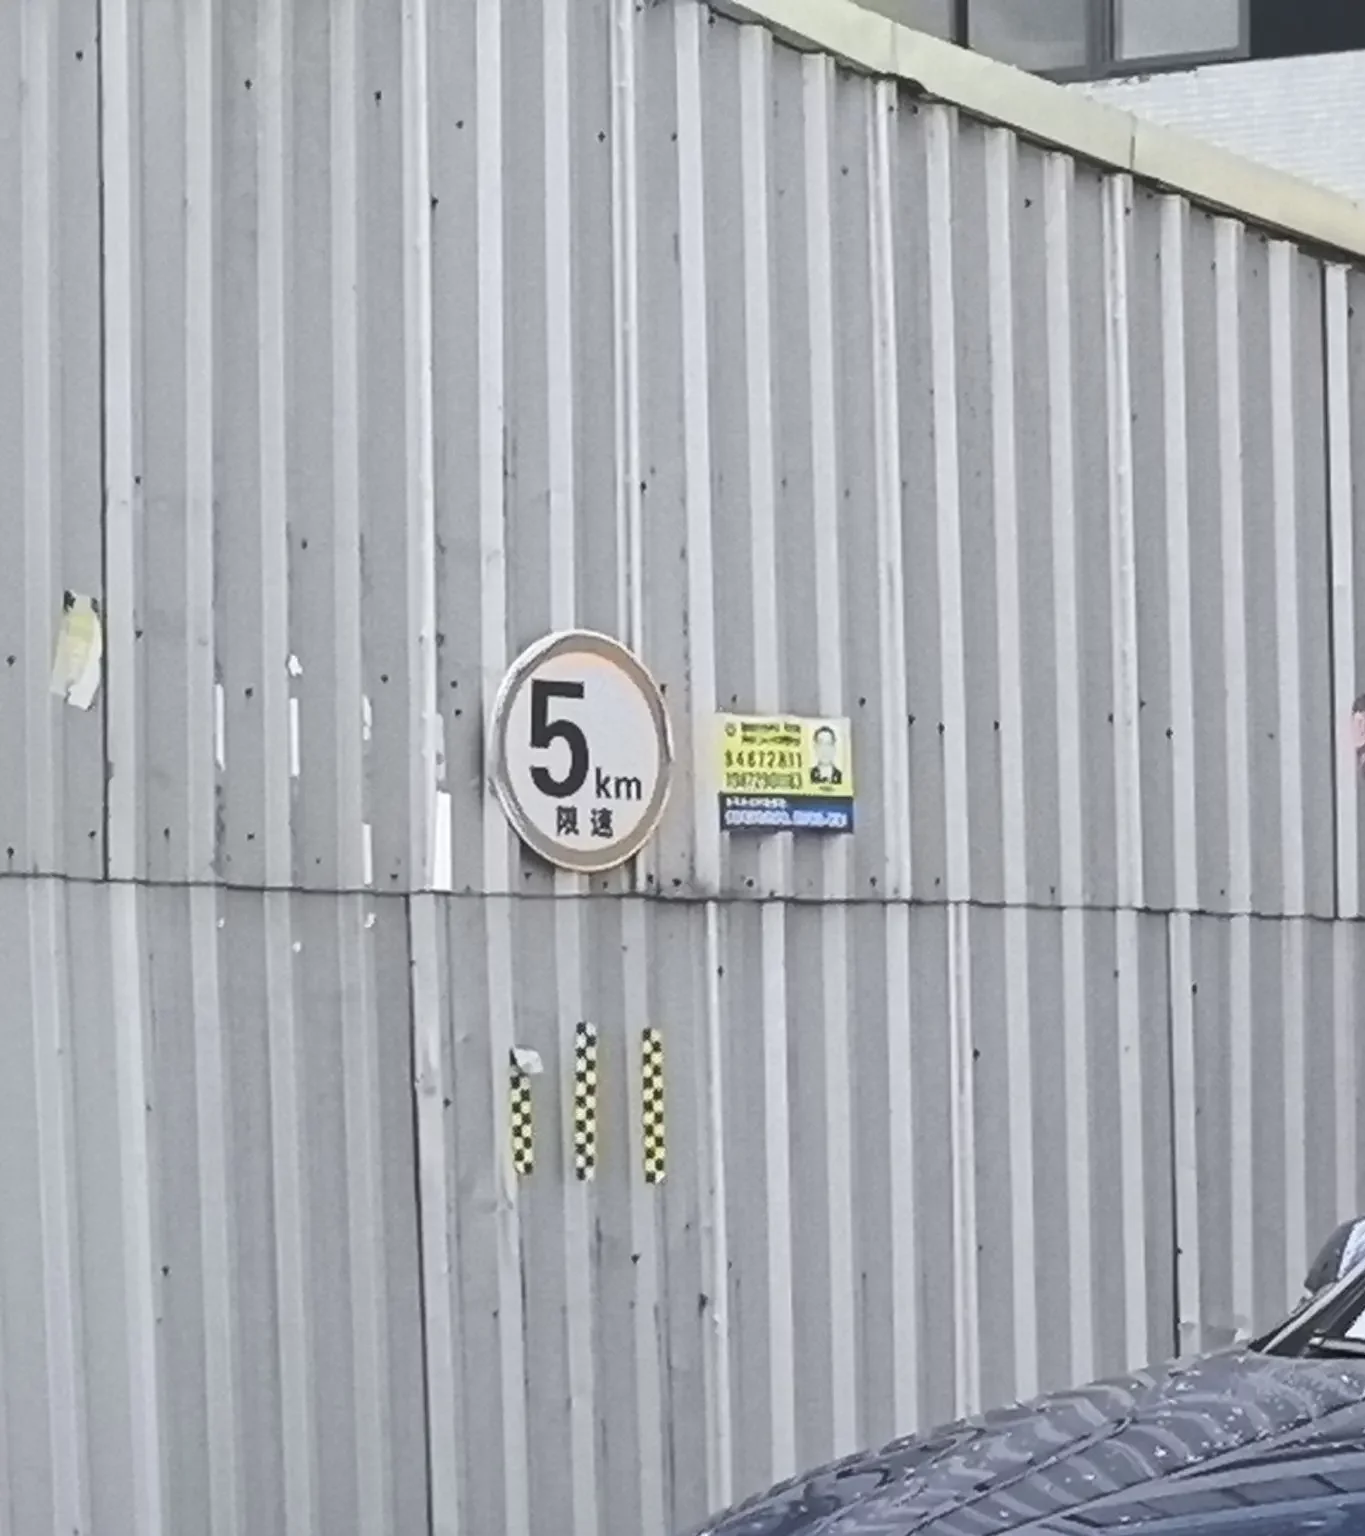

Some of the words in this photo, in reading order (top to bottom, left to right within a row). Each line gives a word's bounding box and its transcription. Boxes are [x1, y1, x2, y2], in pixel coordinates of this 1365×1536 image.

[529, 679, 589, 799] 5
[595, 766, 642, 801] km
[556, 805, 614, 838] 限速
